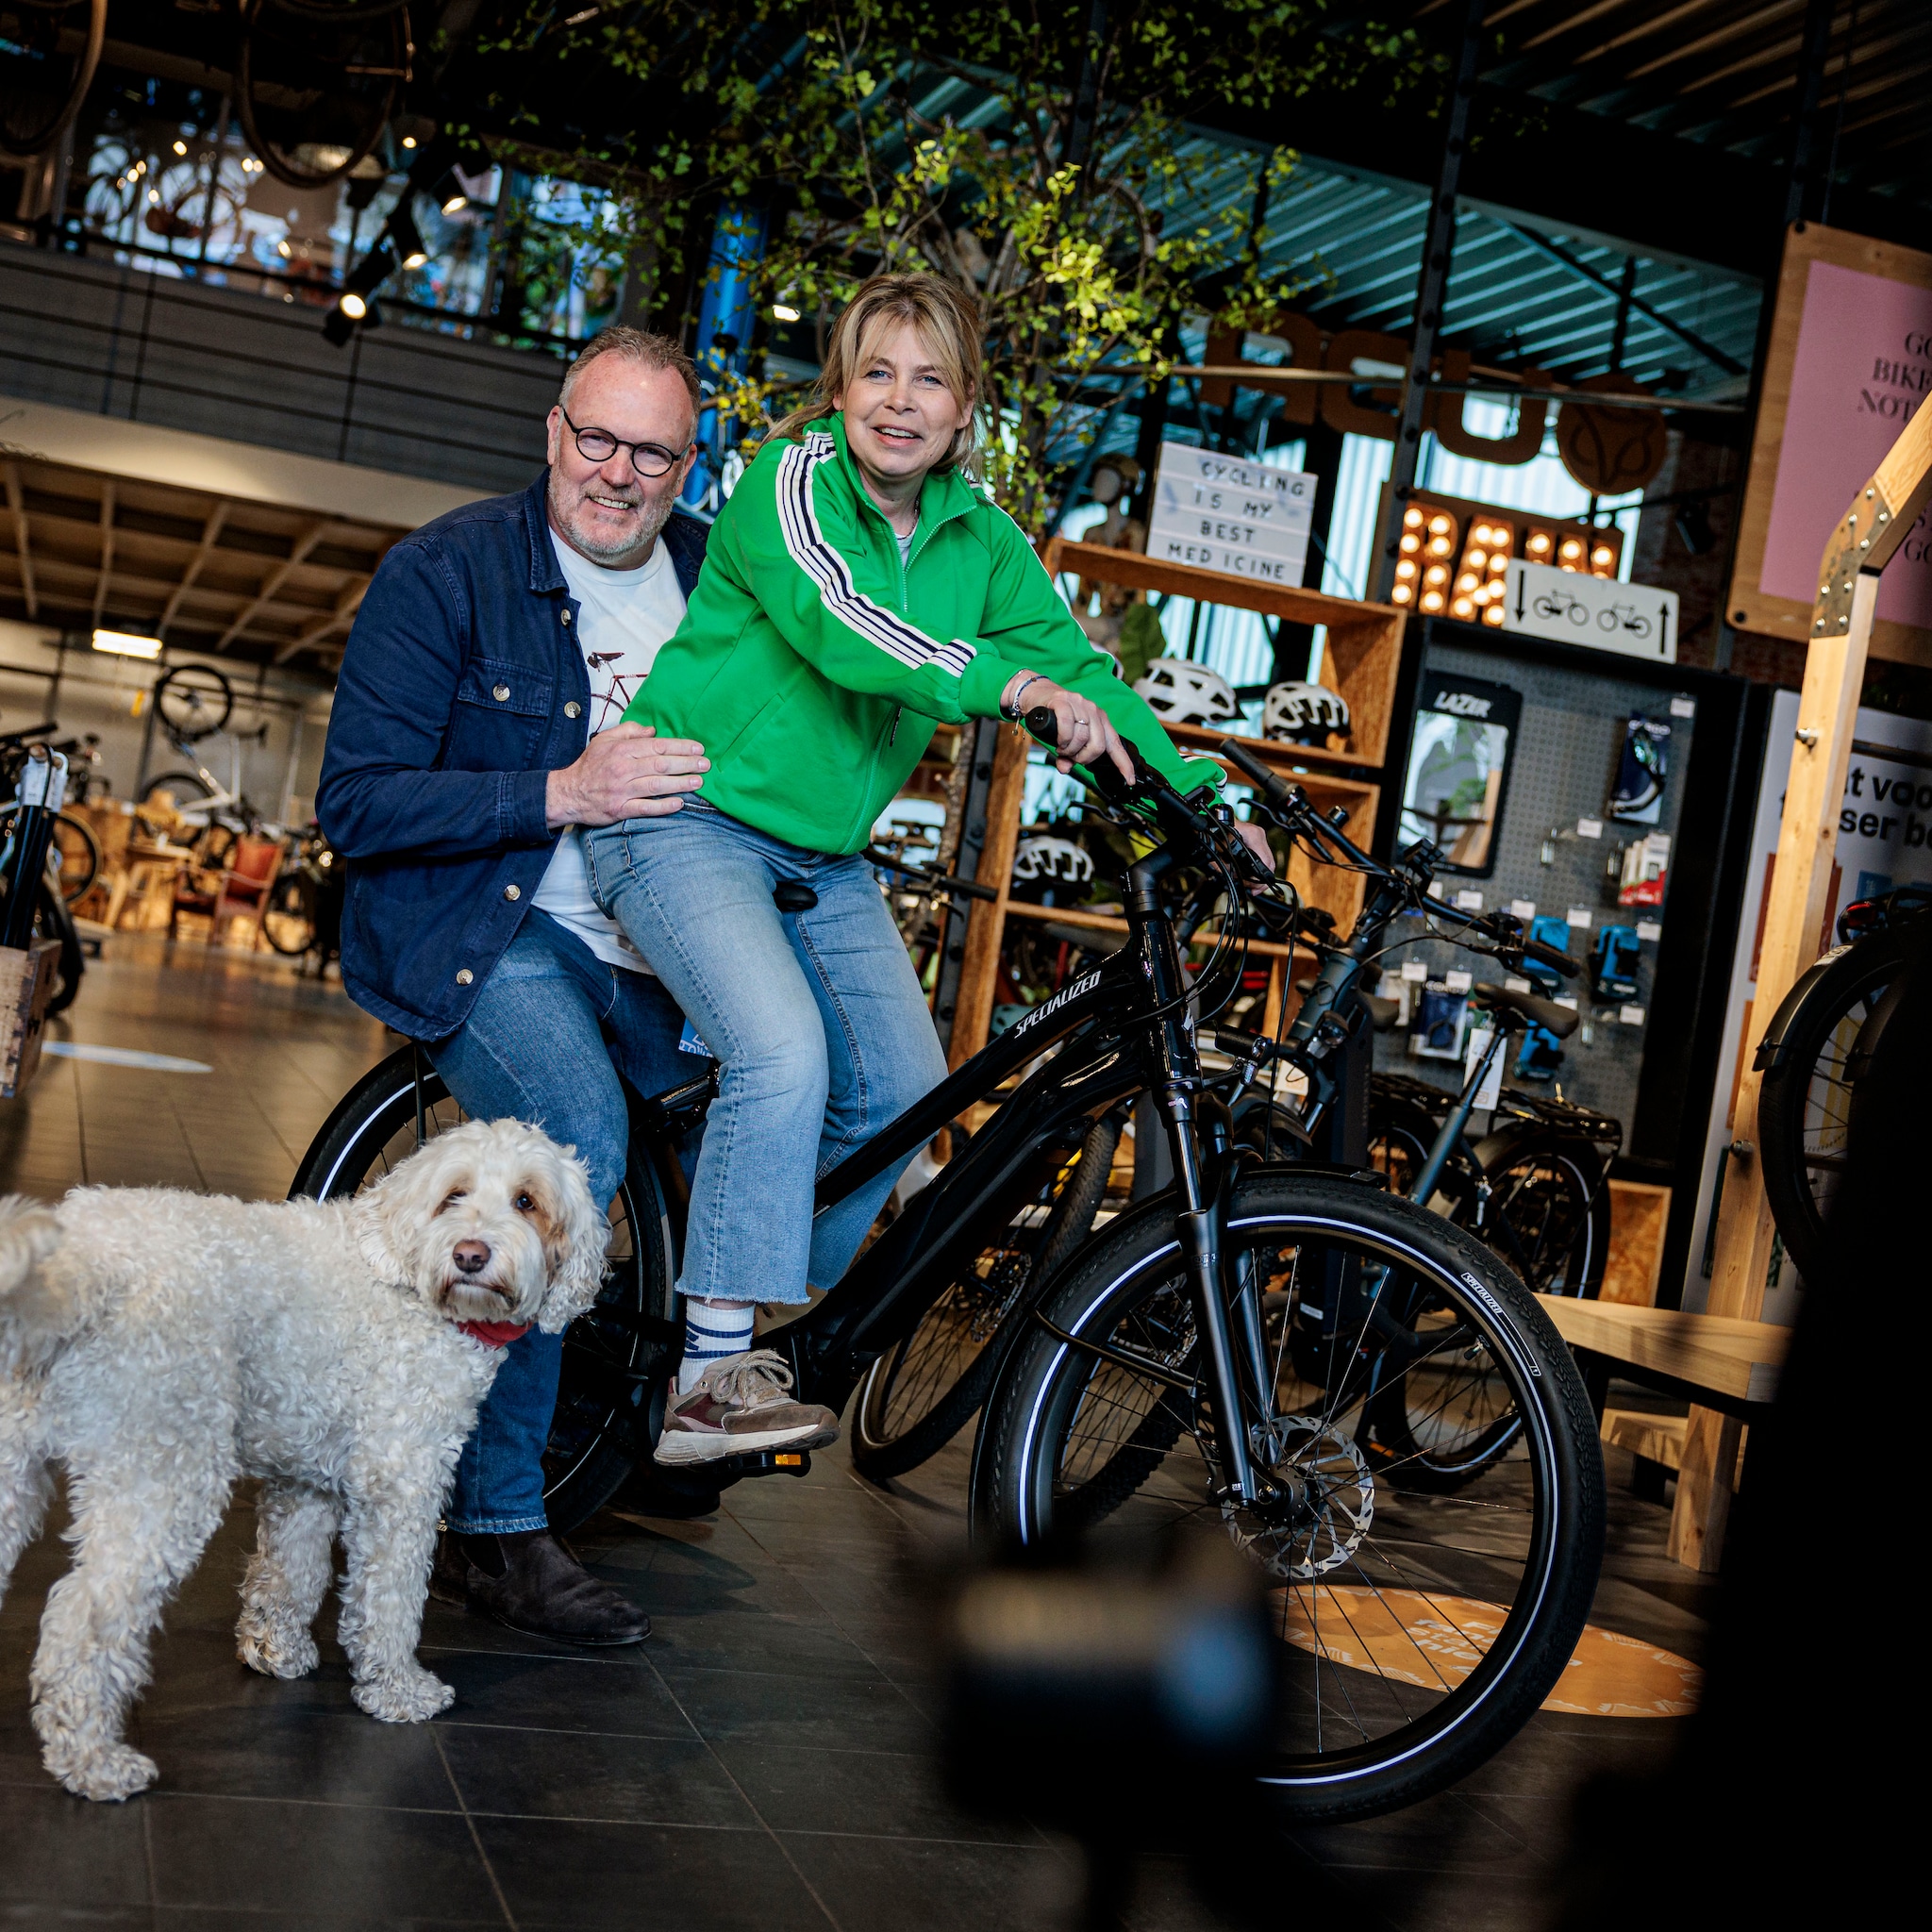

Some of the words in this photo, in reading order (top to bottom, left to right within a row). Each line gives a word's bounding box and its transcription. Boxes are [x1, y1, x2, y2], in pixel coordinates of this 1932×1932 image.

[1201, 460, 1305, 497] CYCLING
[1194, 490, 1223, 509] IS
[1242, 500, 1274, 518] MY
[1199, 520, 1256, 543] BEST
[1167, 542, 1287, 580] MEDICINE
[1014, 970, 1102, 1039] SPECIALIZED
[1461, 1273, 1503, 1314] SPECIALIZED
